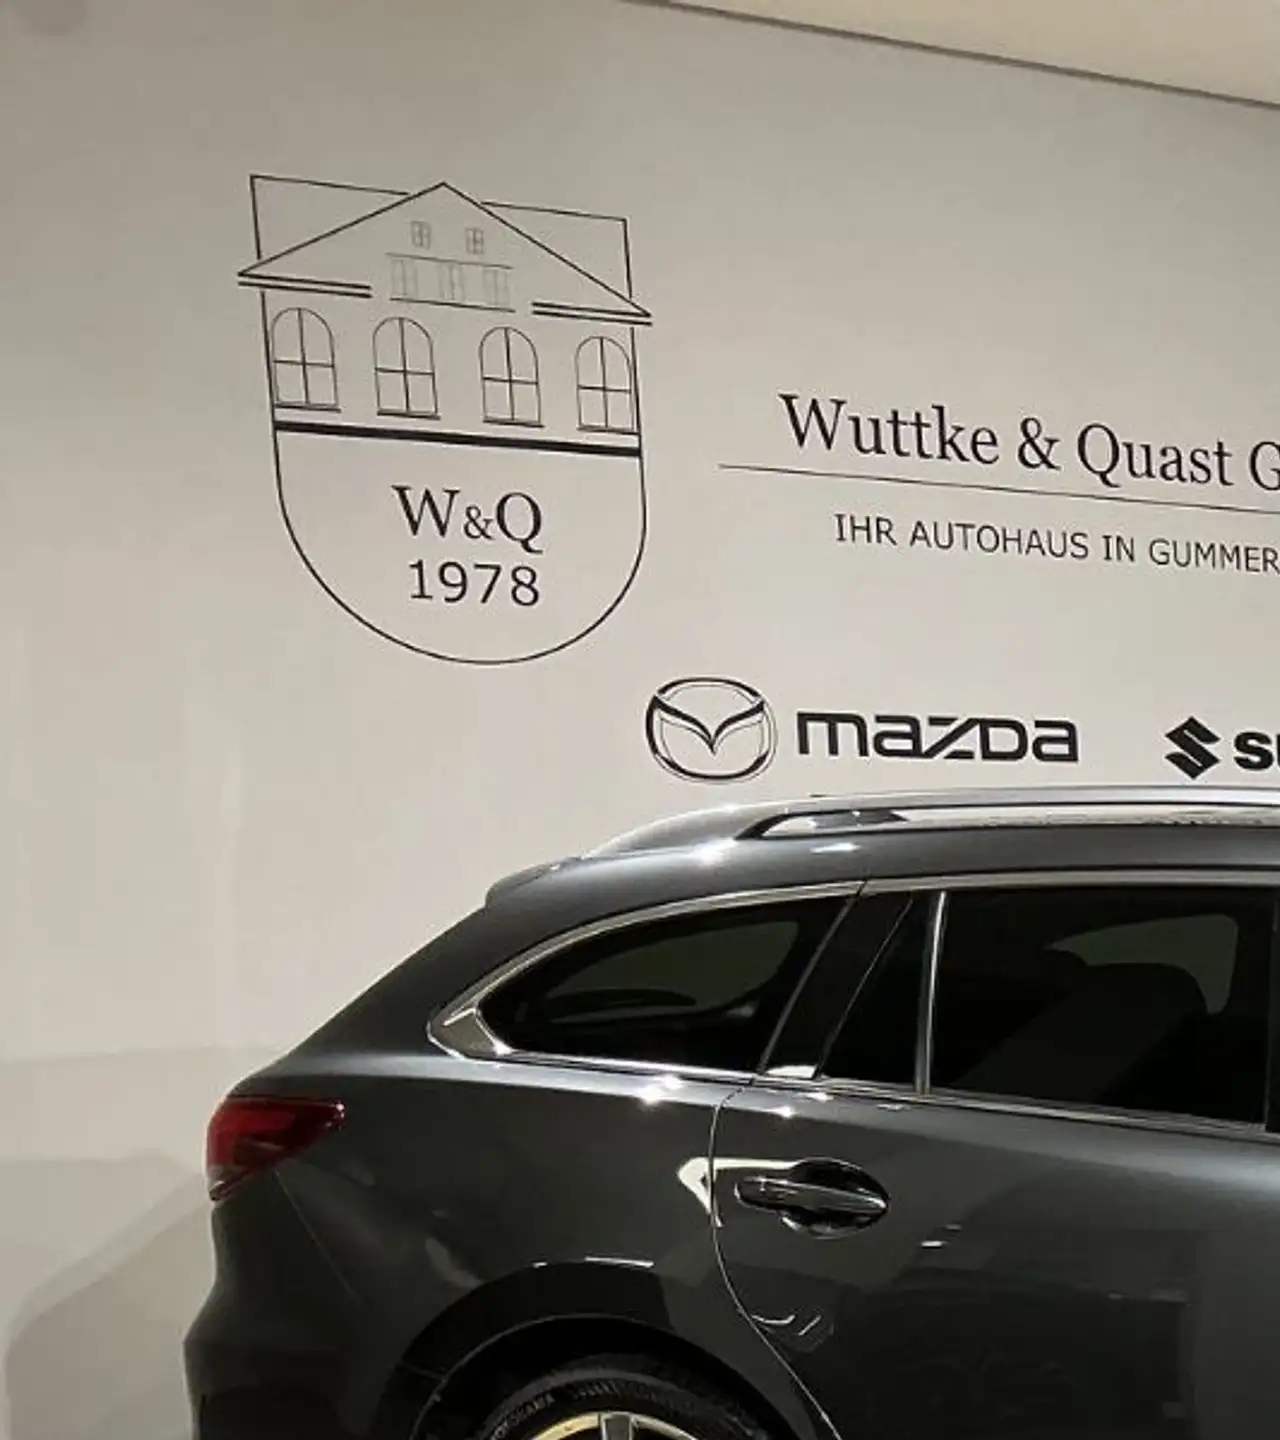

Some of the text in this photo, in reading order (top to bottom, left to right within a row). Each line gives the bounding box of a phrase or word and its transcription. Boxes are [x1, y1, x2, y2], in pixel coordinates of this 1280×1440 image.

[777, 393, 1000, 465] Wuttke
[1017, 417, 1061, 471] &
[1077, 423, 1234, 487] Quast
[390, 484, 544, 556] W&Q
[835, 513, 897, 546] IHR
[909, 520, 1089, 560] AUTOHAUS
[1101, 534, 1135, 563] IN
[408, 559, 540, 607] 1978
